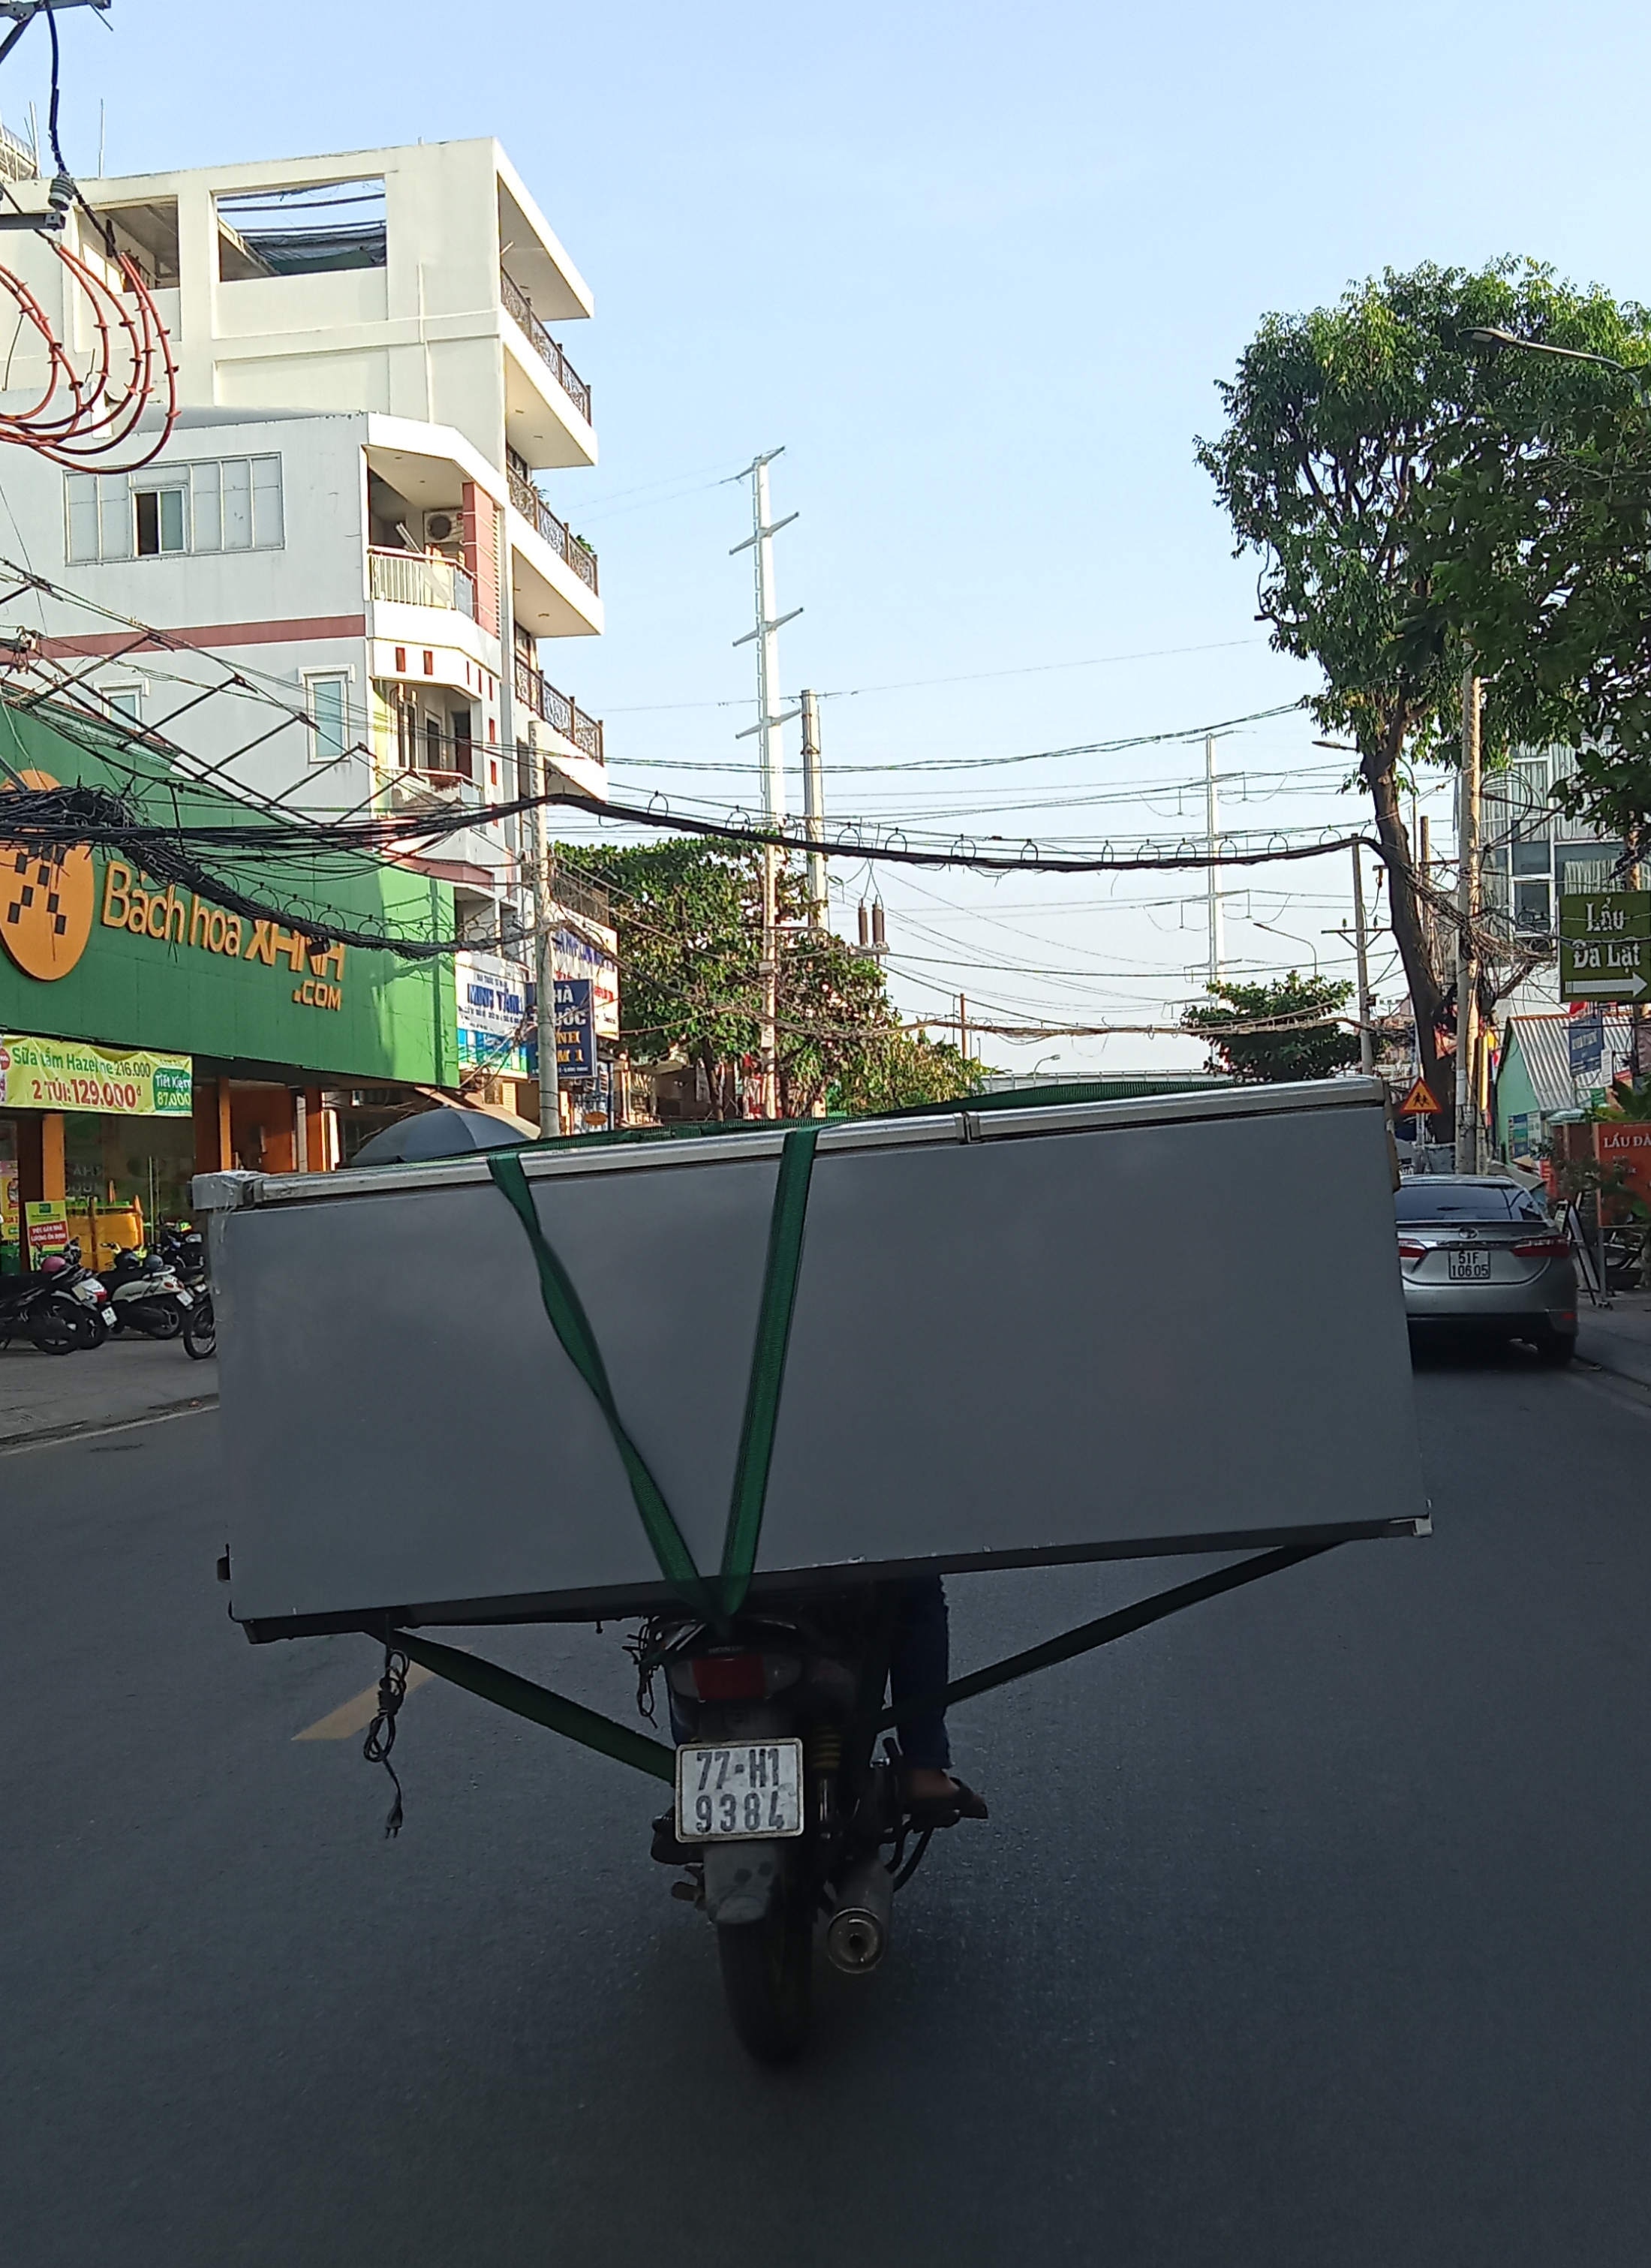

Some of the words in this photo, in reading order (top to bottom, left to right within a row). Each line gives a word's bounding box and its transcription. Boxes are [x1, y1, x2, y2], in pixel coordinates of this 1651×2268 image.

[12, 1046, 38, 1066] Sữa
[66, 1053, 113, 1075] Hazelne
[114, 1060, 152, 1078] 216.000
[31, 1079, 43, 1100] 2
[157, 1090, 191, 1106] 87.000
[1458, 1251, 1480, 1265] 51F
[696, 1748, 780, 1791] 77-H1
[695, 1791, 785, 1833] 9384
